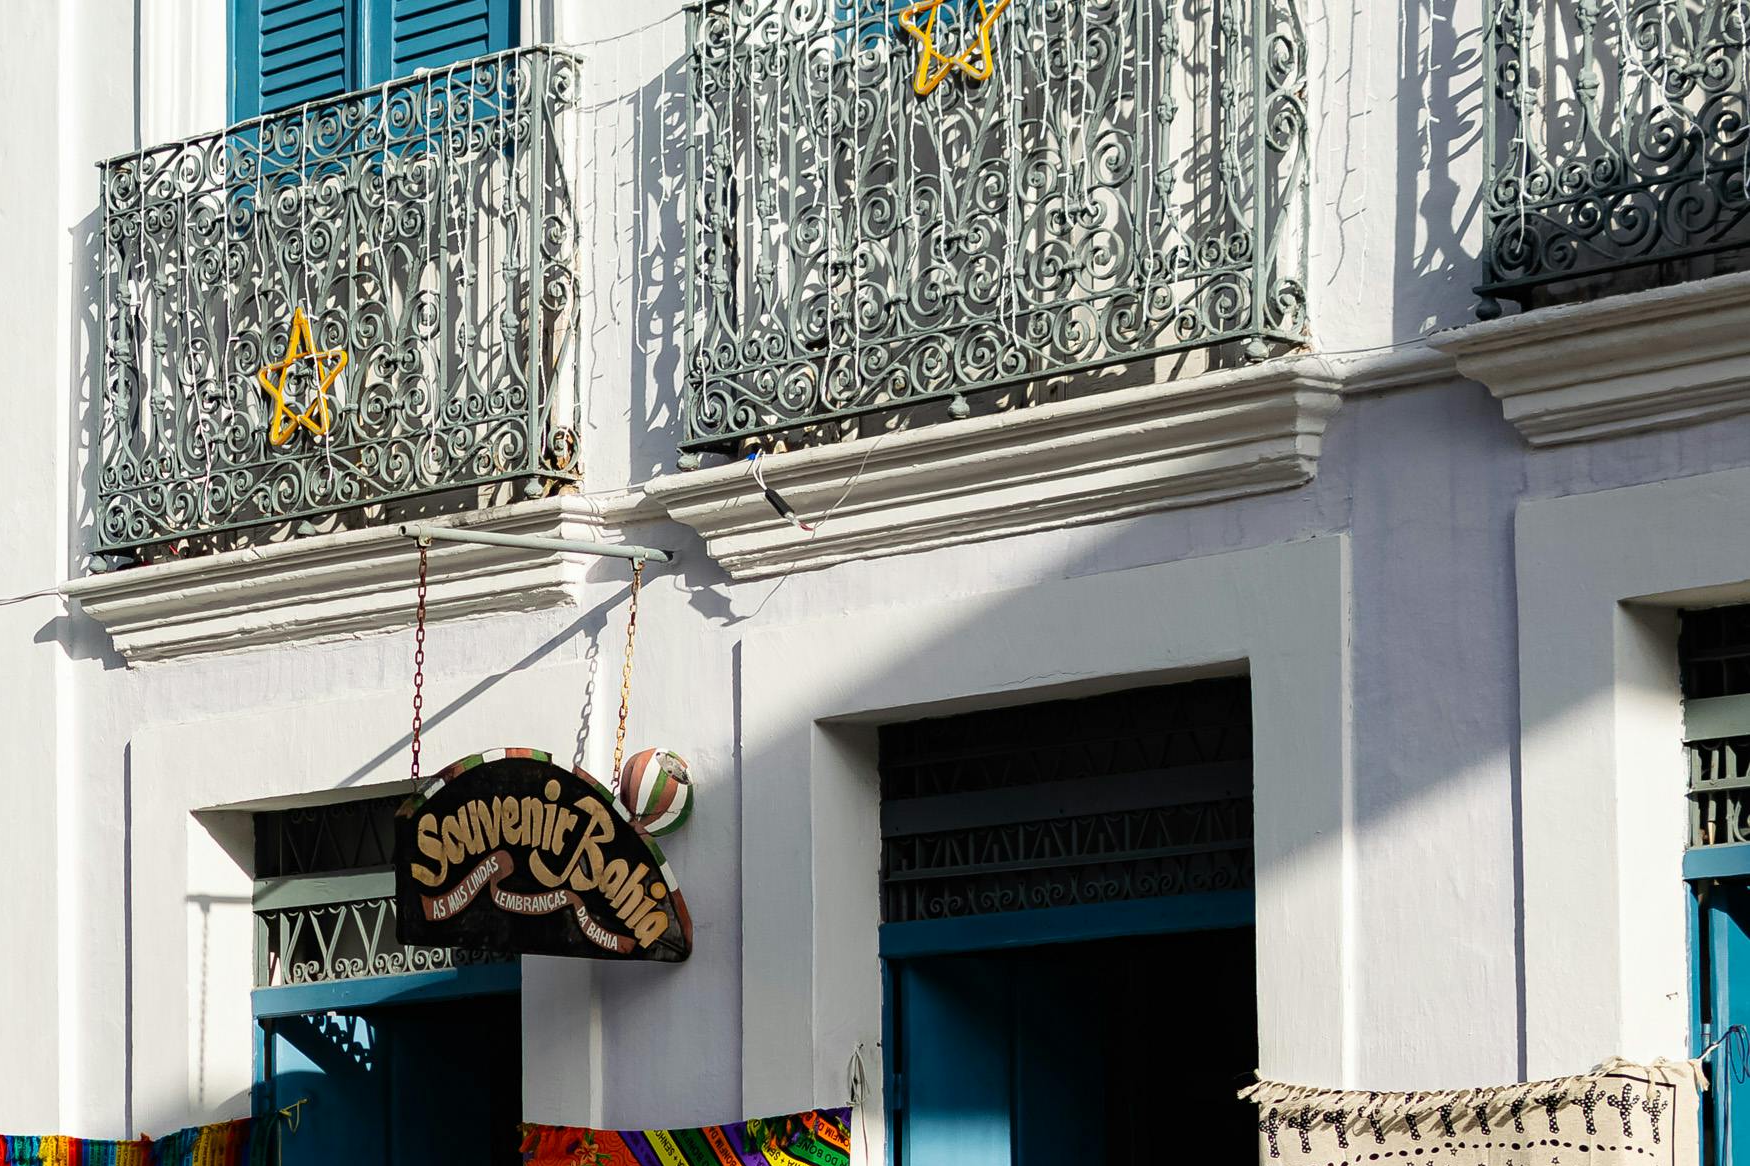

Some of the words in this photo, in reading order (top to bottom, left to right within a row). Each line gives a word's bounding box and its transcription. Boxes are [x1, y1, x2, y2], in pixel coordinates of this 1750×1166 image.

[411, 780, 577, 887] Souvenir
[529, 796, 669, 948] Bahia
[433, 899, 446, 920] AS
[447, 886, 468, 914] MAIS
[466, 856, 499, 895] LINDAS
[494, 889, 568, 912] LEMBRANÇAS
[576, 905, 589, 928] DA
[586, 921, 618, 950] BAHIA
[824, 1154, 837, 1166] DO
